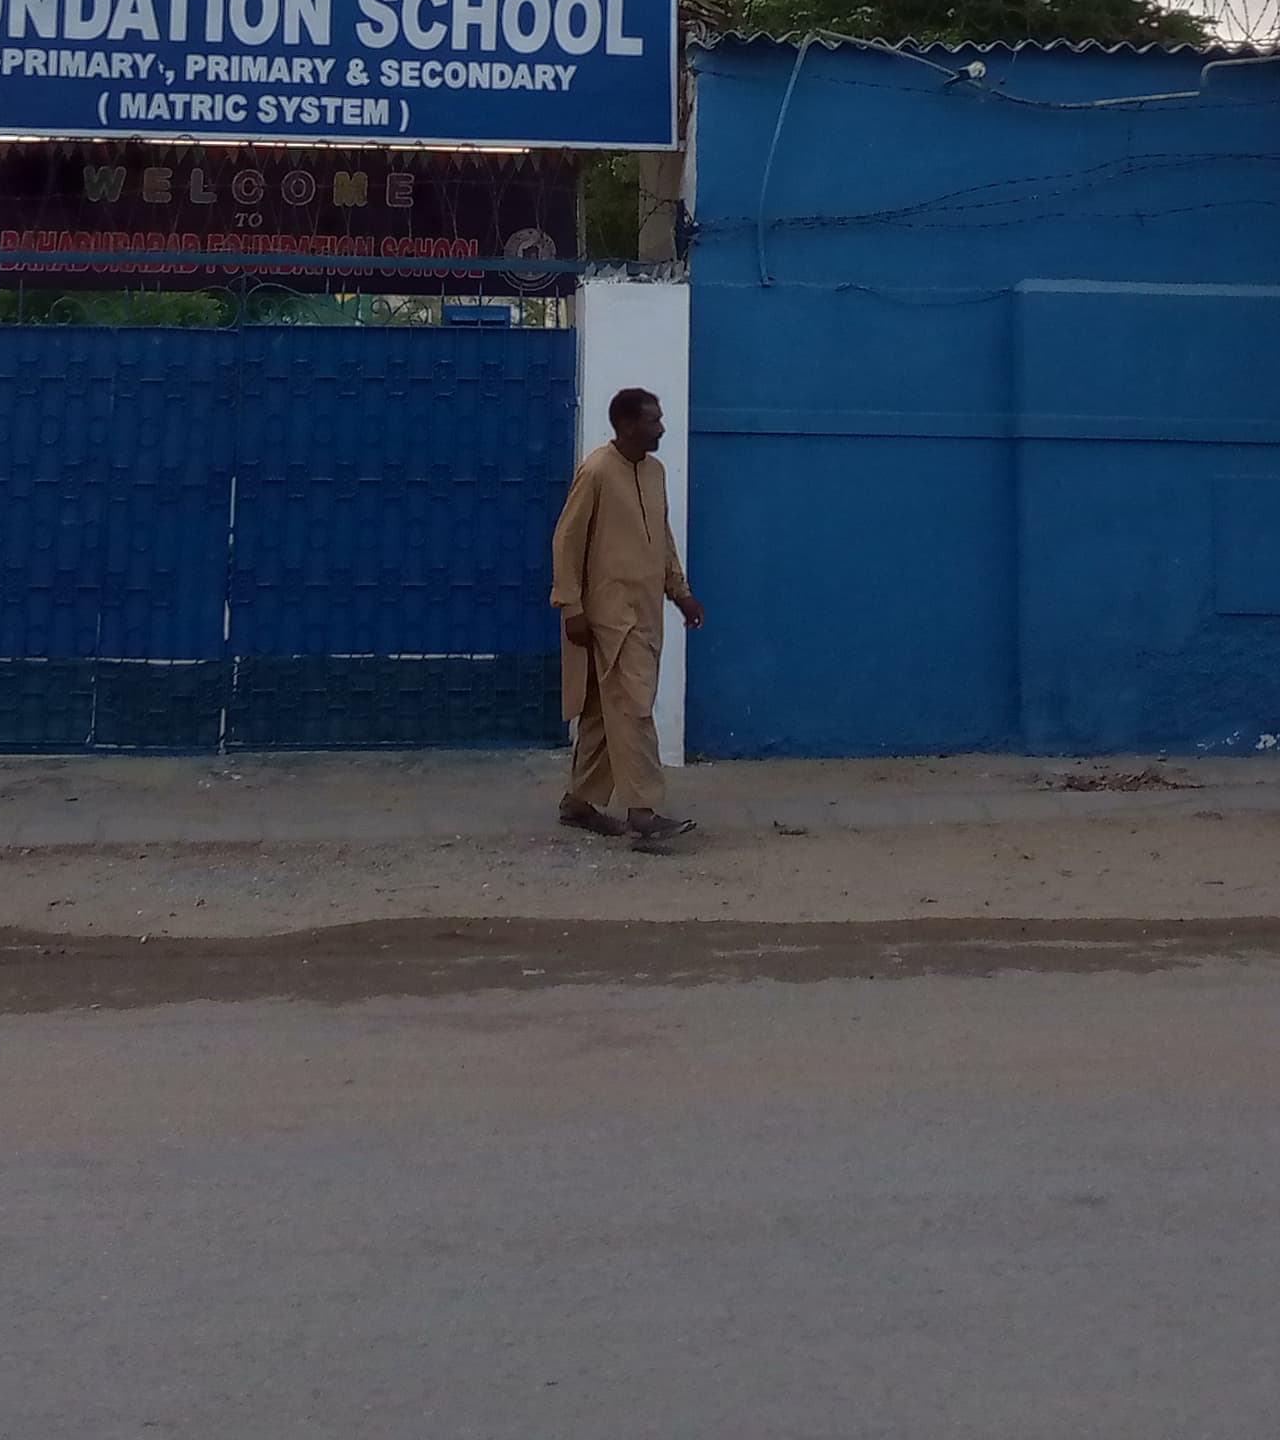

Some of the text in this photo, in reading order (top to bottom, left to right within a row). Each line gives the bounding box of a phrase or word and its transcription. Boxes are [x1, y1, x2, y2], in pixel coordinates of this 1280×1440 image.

[185, 54, 336, 85] PRIMARY
[345, 58, 371, 86] &
[379, 59, 578, 92] SECONDARY
[81, 165, 416, 208] WELCOME
[235, 212, 264, 229] TO
[205, 231, 376, 277] FOUNDATION
[379, 235, 486, 279] SCHOOL
